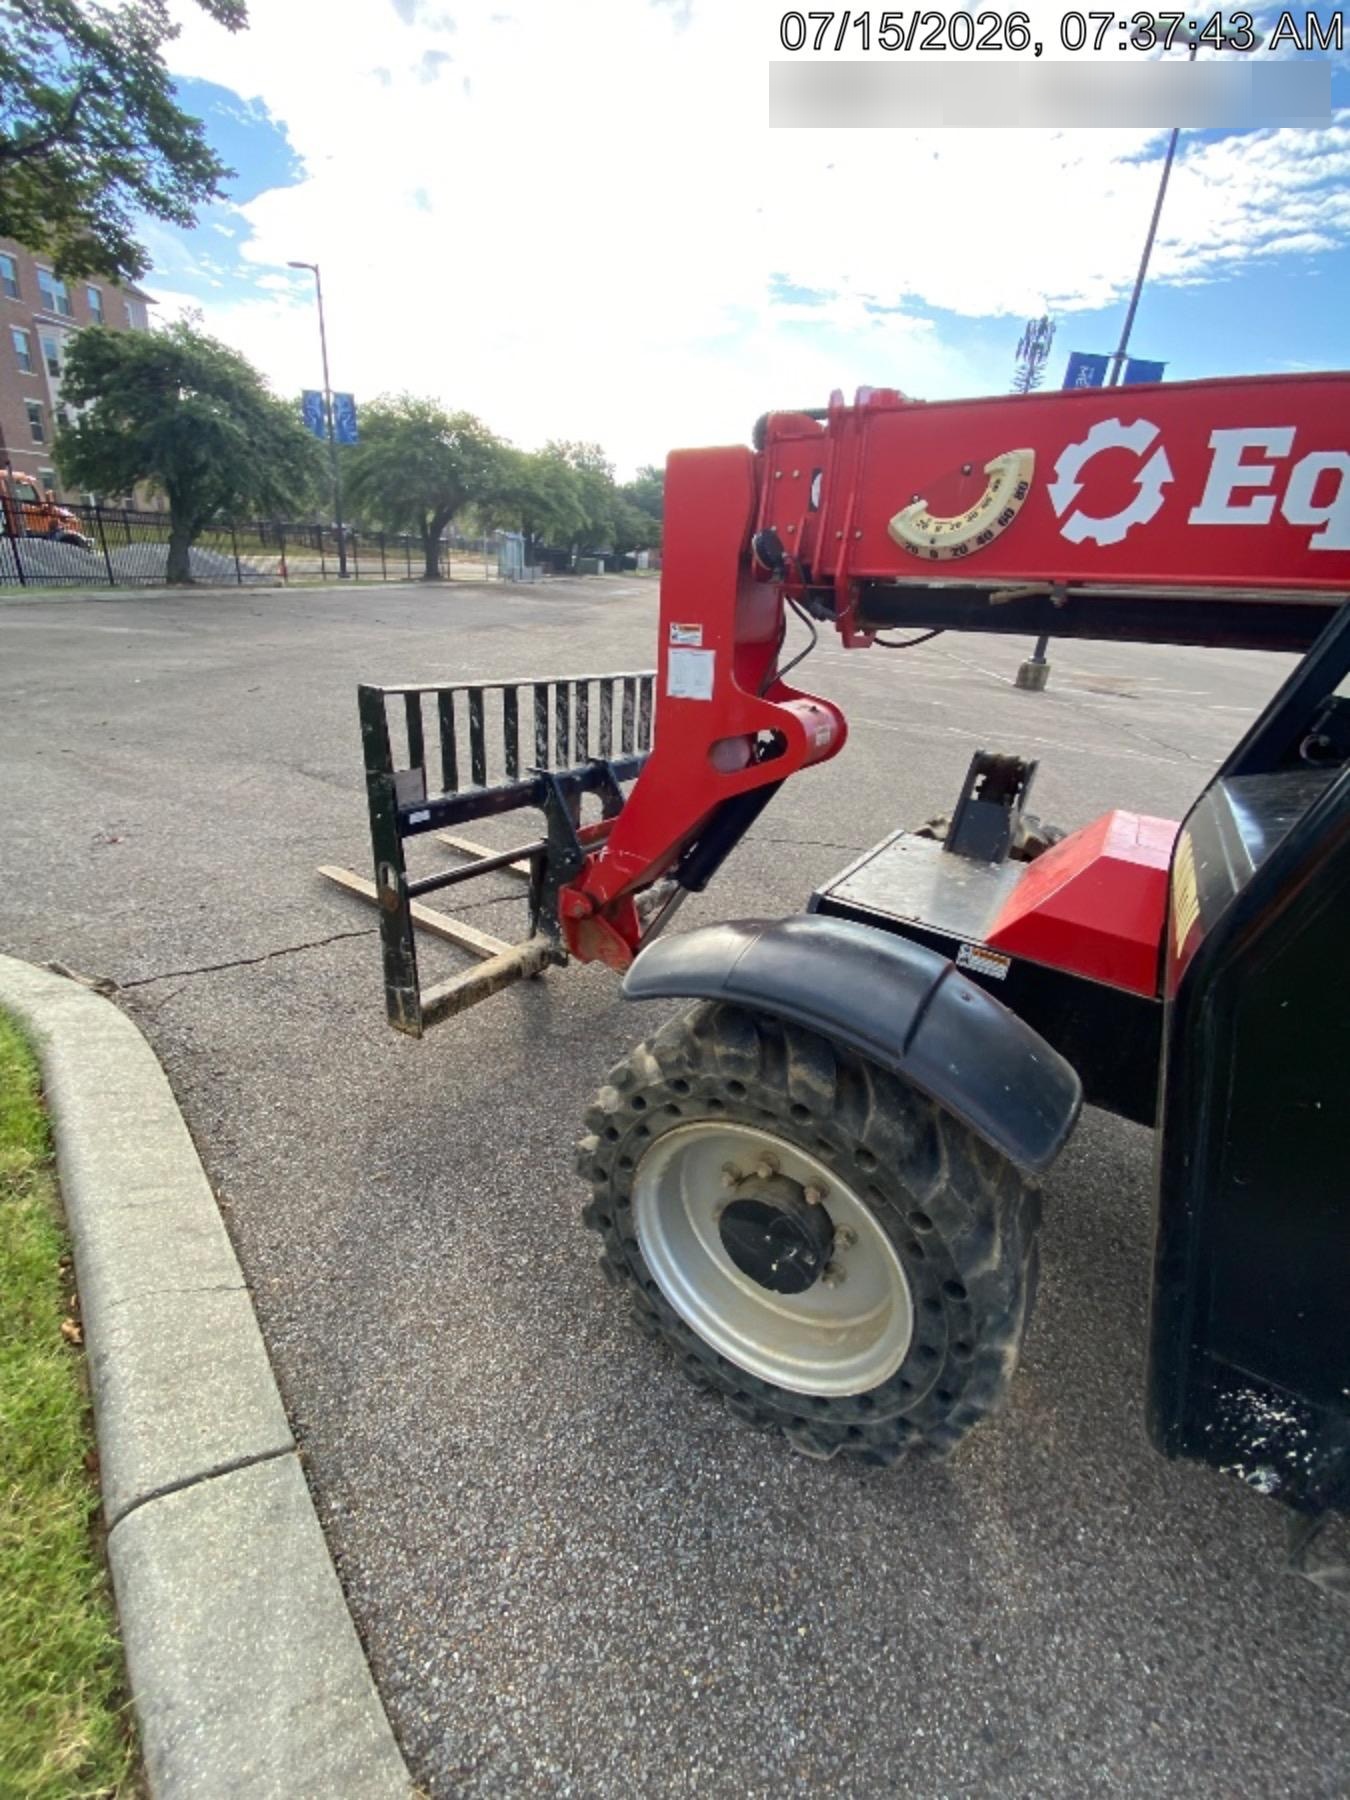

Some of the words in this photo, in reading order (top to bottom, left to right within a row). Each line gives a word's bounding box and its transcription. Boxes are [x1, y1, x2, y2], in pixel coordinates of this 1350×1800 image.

[951, 543, 968, 557] 20
[976, 529, 994, 545] 40
[997, 507, 1015, 527] 60
[1014, 481, 1029, 501] 80
[1187, 426, 1350, 550] Eq
